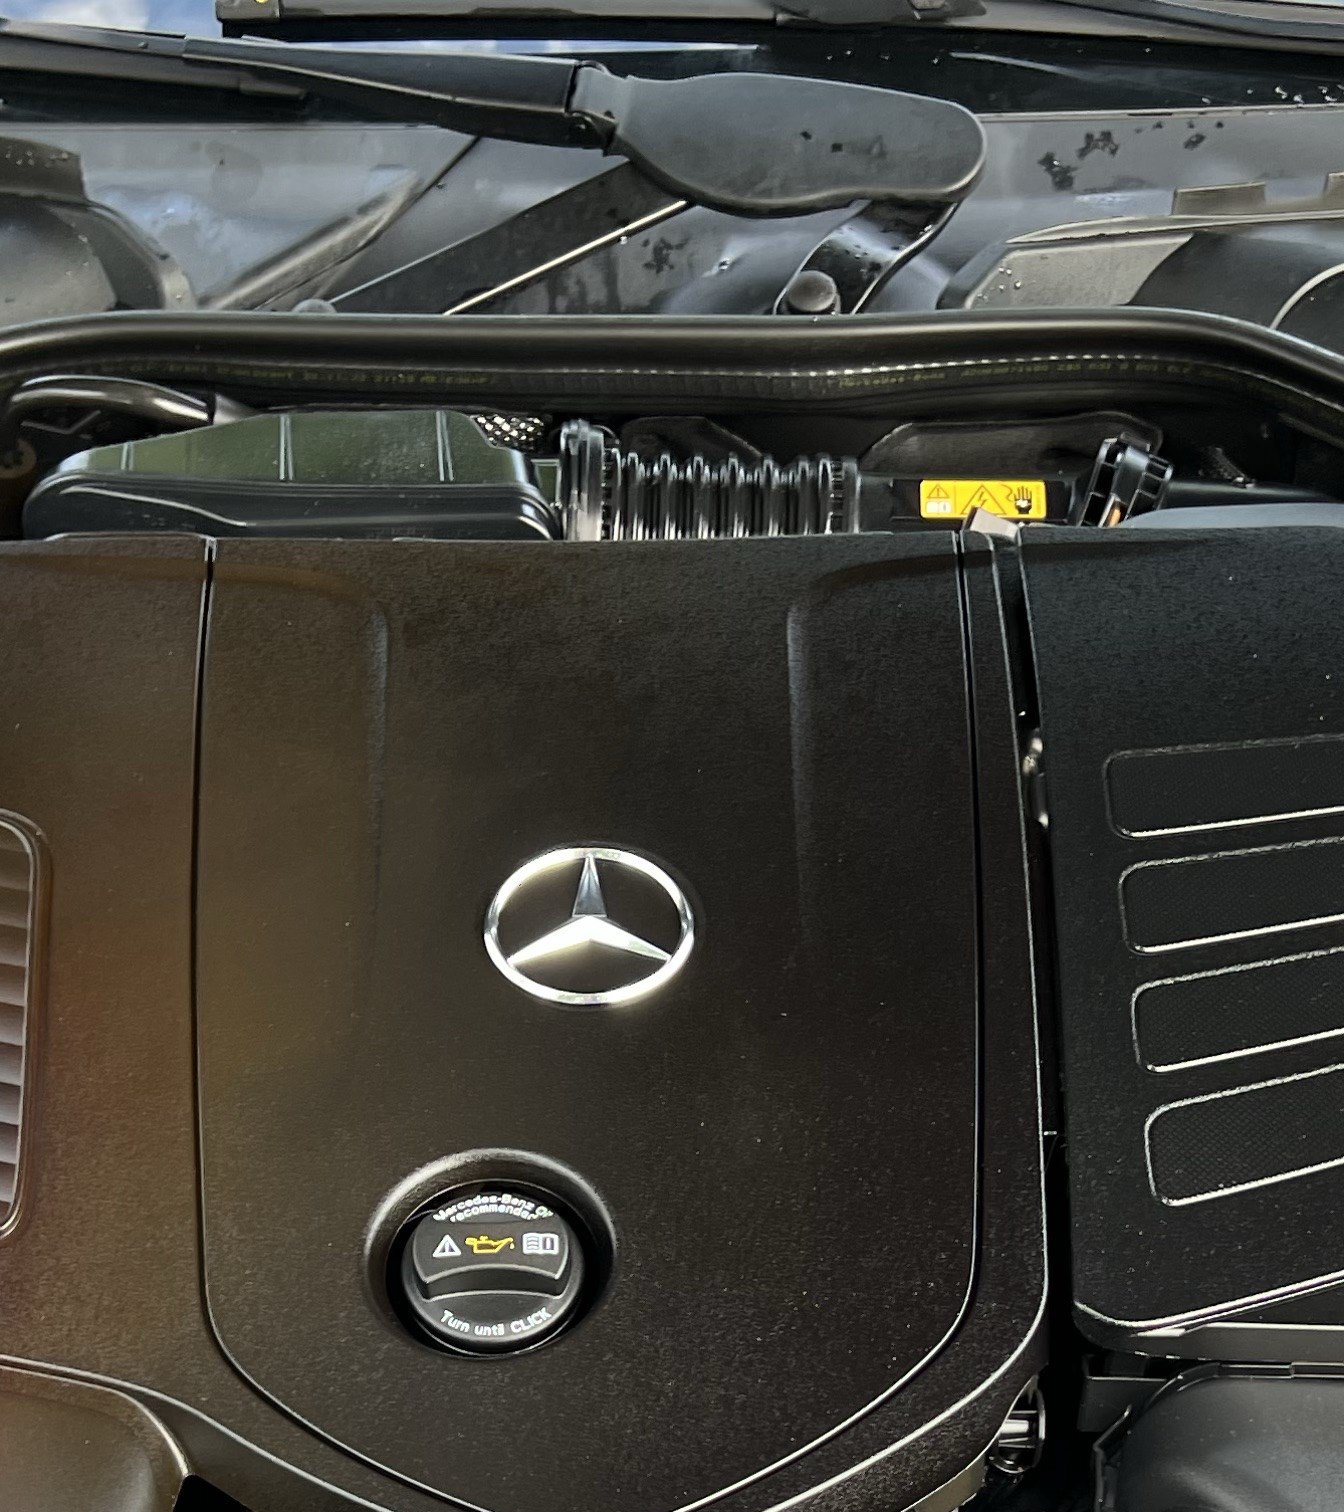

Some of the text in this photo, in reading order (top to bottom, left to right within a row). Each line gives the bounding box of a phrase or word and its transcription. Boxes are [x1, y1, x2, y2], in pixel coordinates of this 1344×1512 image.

[432, 1193, 535, 1221] Mercedes-Benz
[440, 1307, 552, 1336] Turn until CLICK
